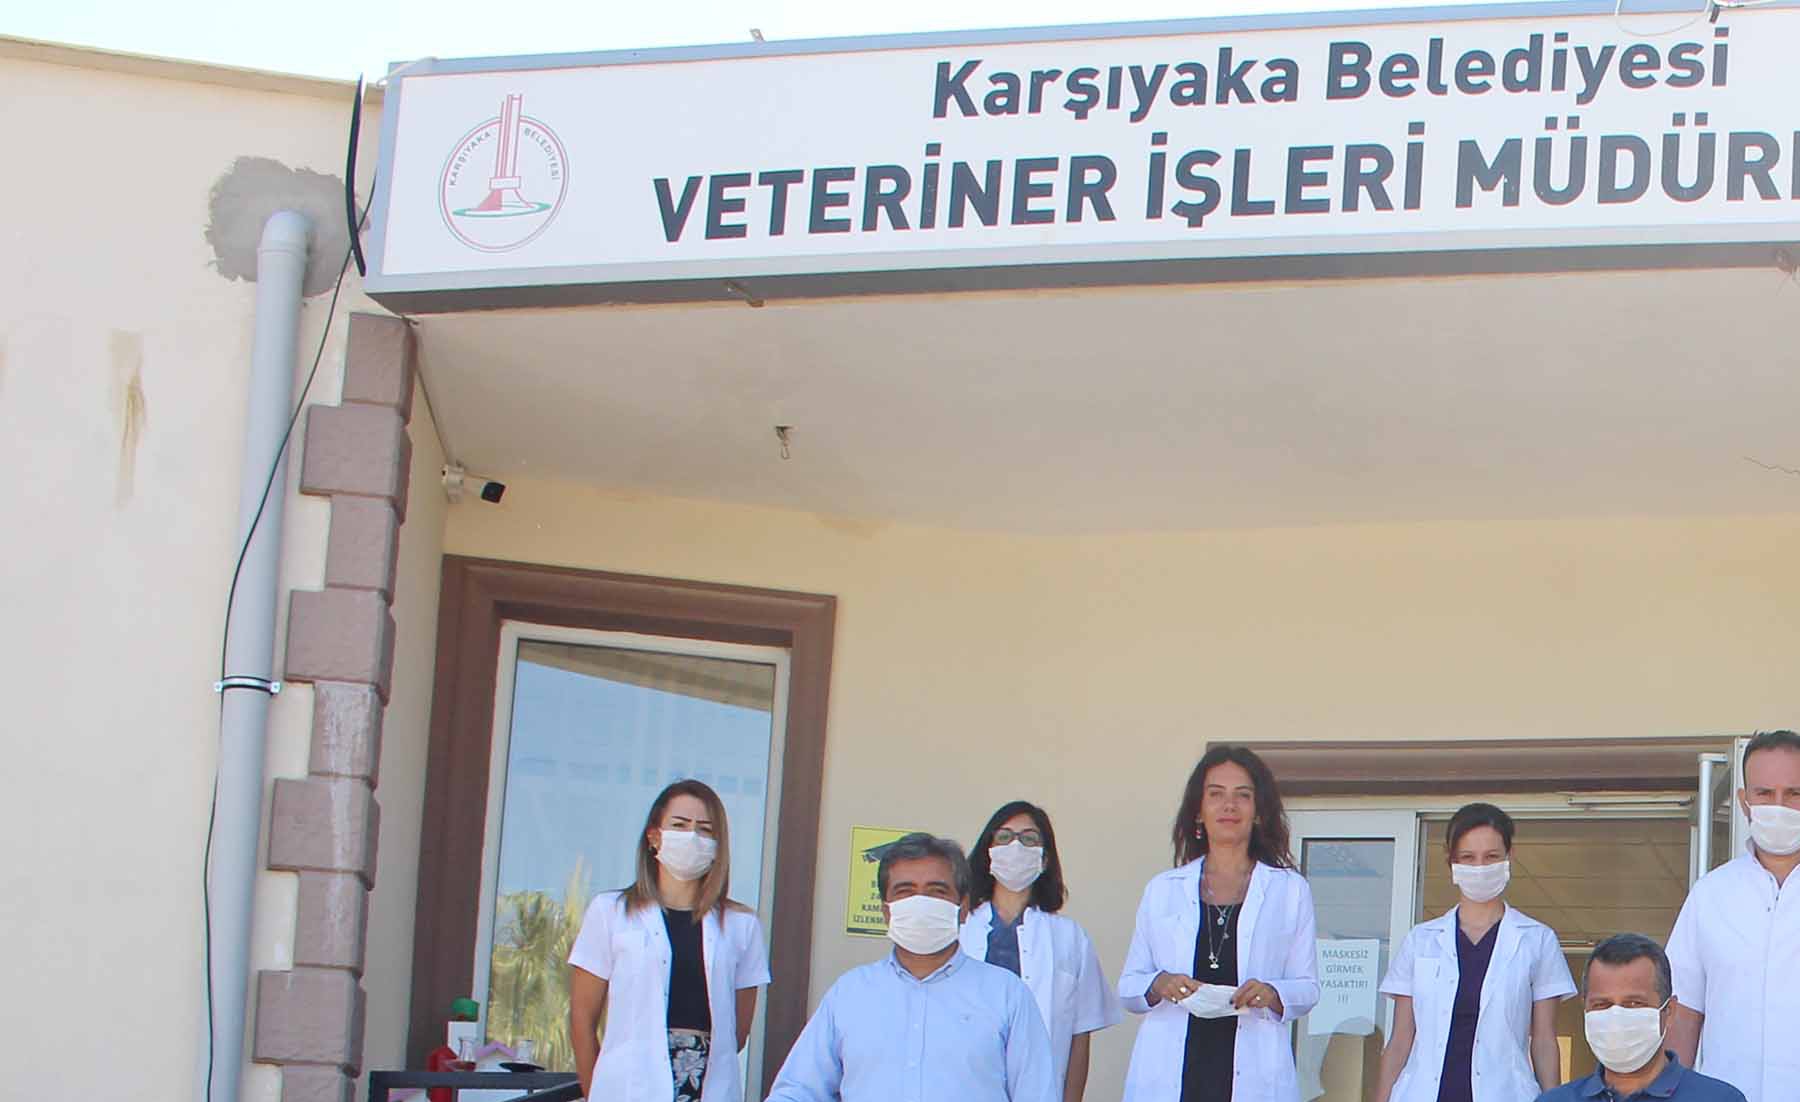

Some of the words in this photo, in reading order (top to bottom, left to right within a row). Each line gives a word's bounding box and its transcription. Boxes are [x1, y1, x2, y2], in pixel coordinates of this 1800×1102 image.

[934, 47, 1299, 122] Karşıyaka
[1327, 28, 1729, 105] Belediyesi
[449, 130, 491, 187] KARŞIYAKA
[523, 127, 561, 181] BELEDİYESİ
[654, 144, 1117, 243] VETERİNER
[1146, 122, 1425, 227] İŞLERİ
[1322, 948, 1369, 960] MASKESİZ
[1326, 963, 1364, 974] GİRMEK
